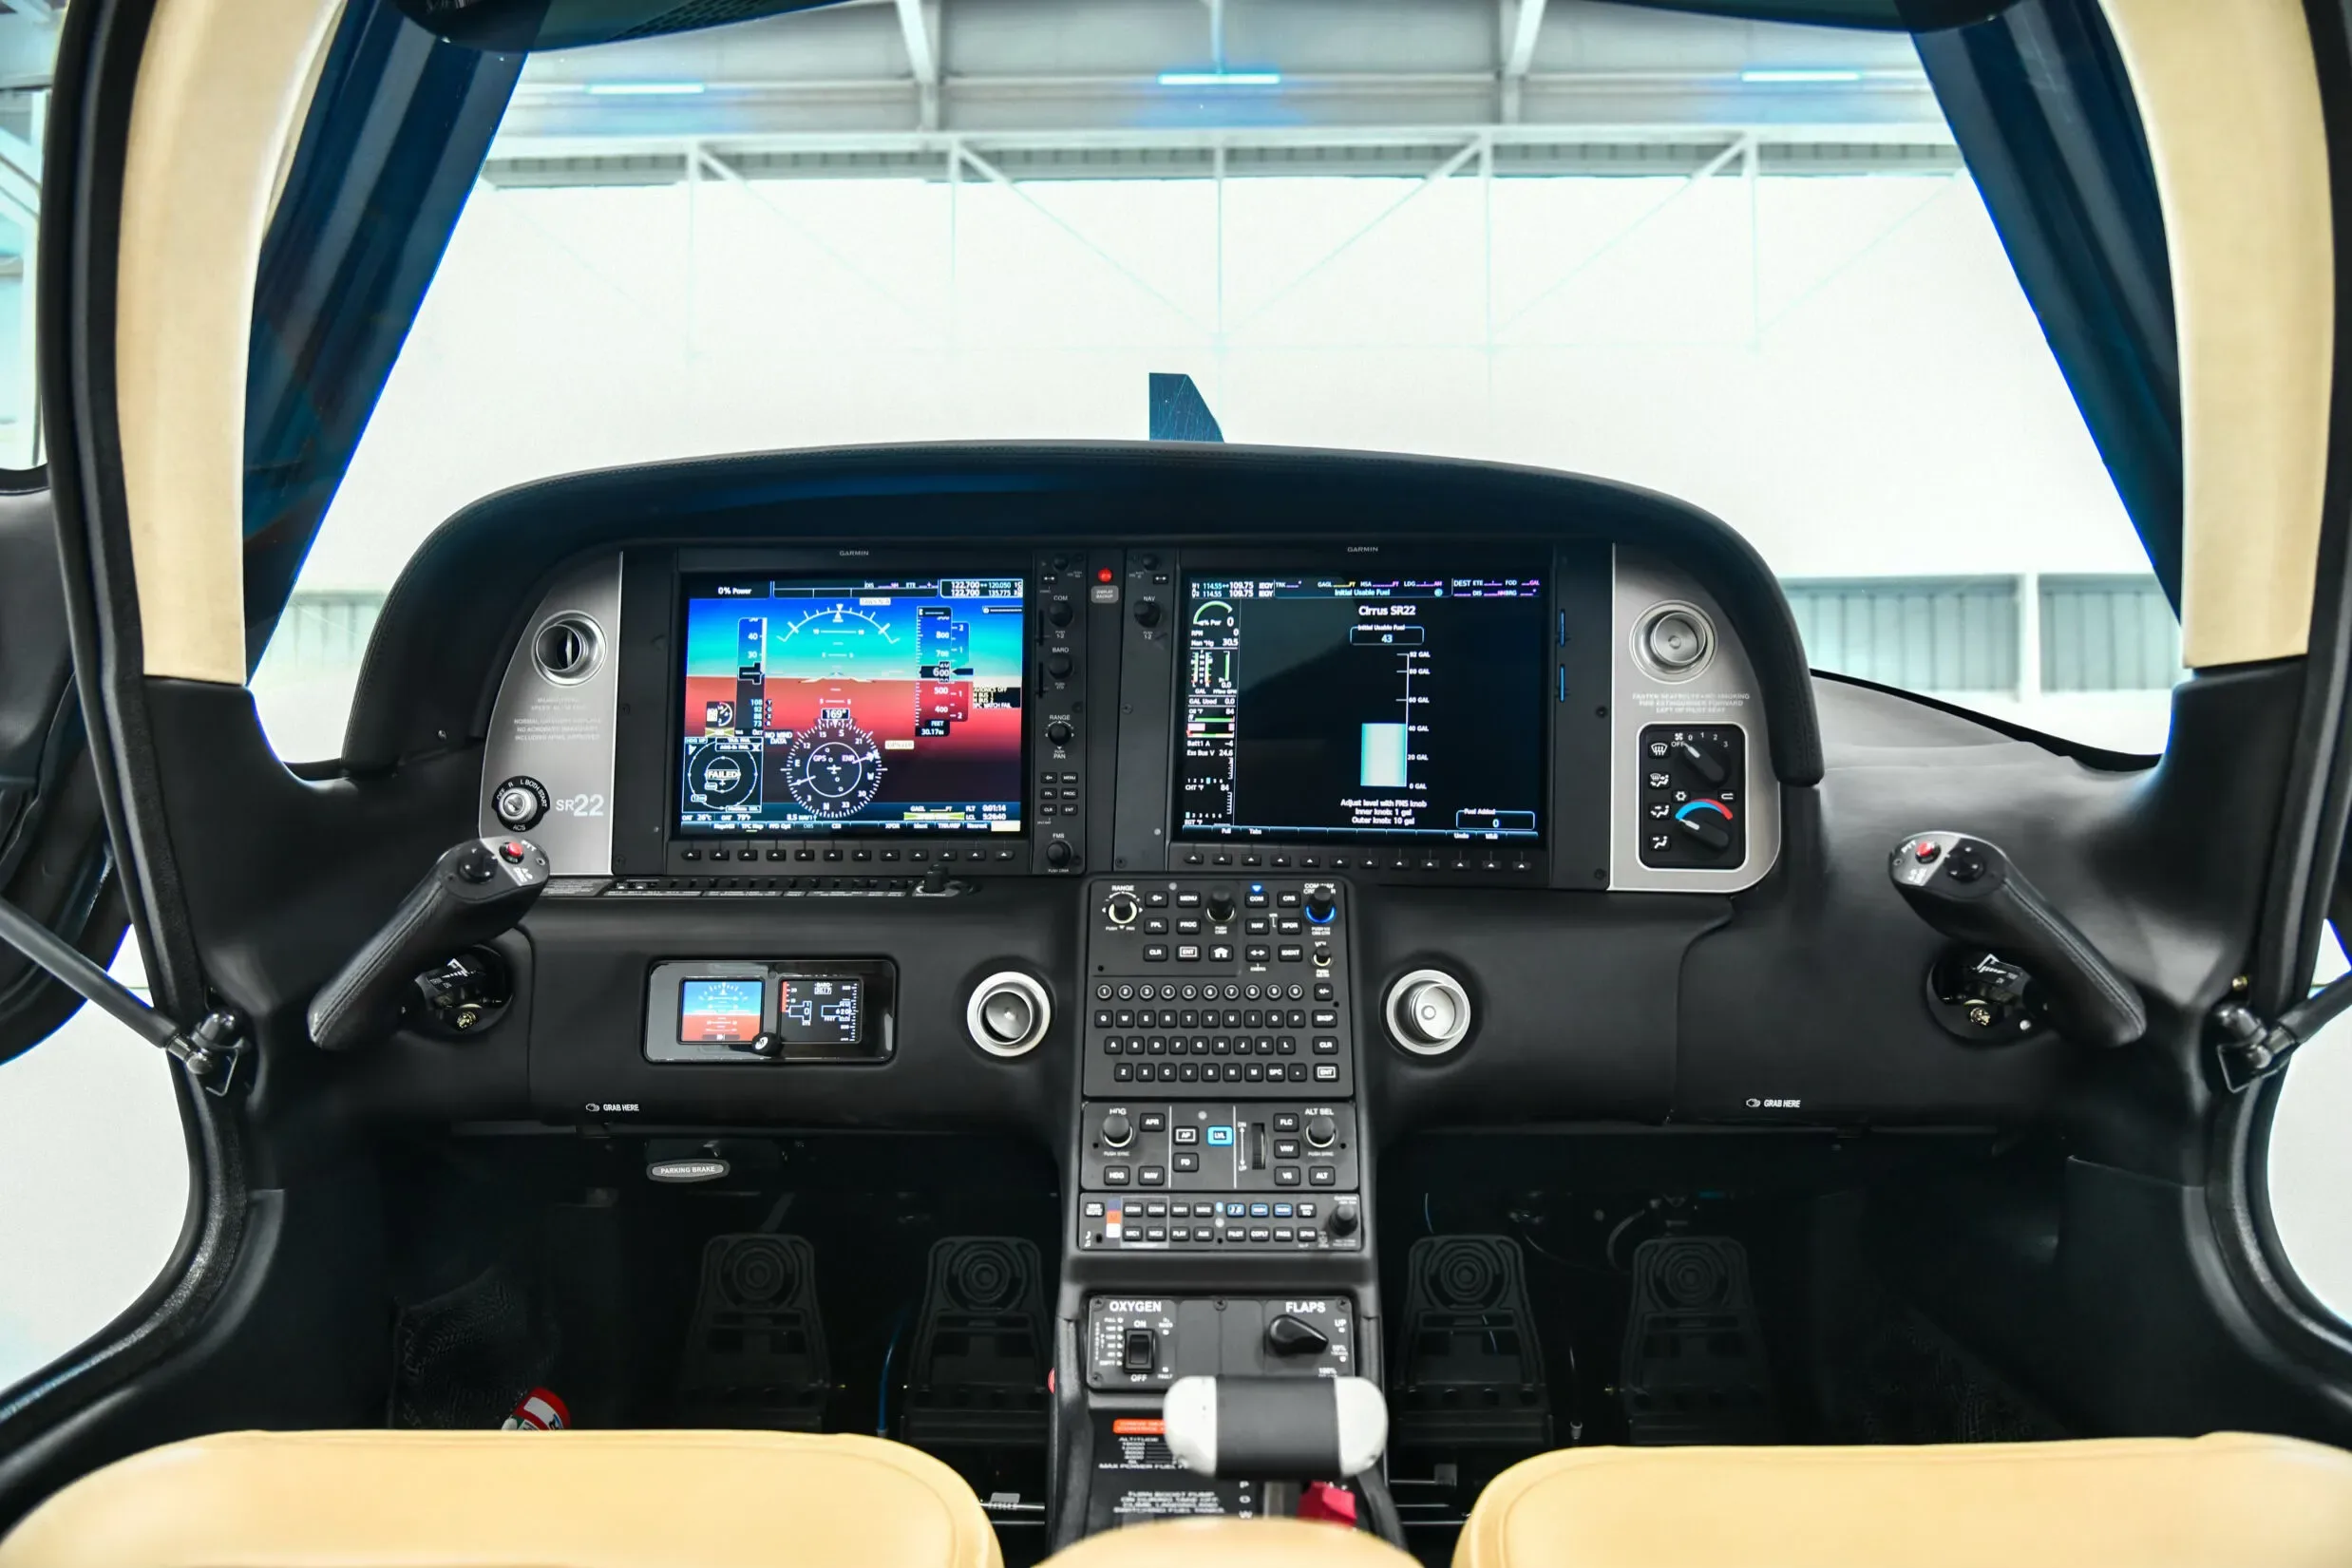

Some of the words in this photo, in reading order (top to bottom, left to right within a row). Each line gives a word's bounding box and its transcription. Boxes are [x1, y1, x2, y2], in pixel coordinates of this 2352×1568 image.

[717, 587, 731, 595] 0%
[732, 587, 752, 595] Power
[1358, 605, 1389, 615] Cirrus
[1391, 605, 1416, 615] SR22
[1226, 616, 1234, 627] 0
[1233, 628, 1240, 636] 0
[1381, 634, 1393, 643] 43
[934, 687, 948, 695] 500
[825, 709, 846, 719] 169°
[794, 759, 801, 767] E
[496, 787, 506, 801] OFF
[524, 779, 540, 791] BOTH
[537, 788, 547, 807] START
[556, 794, 605, 817] SR22
[1340, 799, 1362, 807] Adjust
[1492, 819, 1499, 828] 0
[521, 840, 537, 851] PTT
[1763, 1099, 1782, 1107] GRAB
[1783, 1099, 1801, 1107] HERE
[1109, 1300, 1162, 1312] OXYGEN
[1285, 1301, 1326, 1313] FLAPS
[1133, 1319, 1147, 1328] ON
[1334, 1318, 1347, 1327] UP
